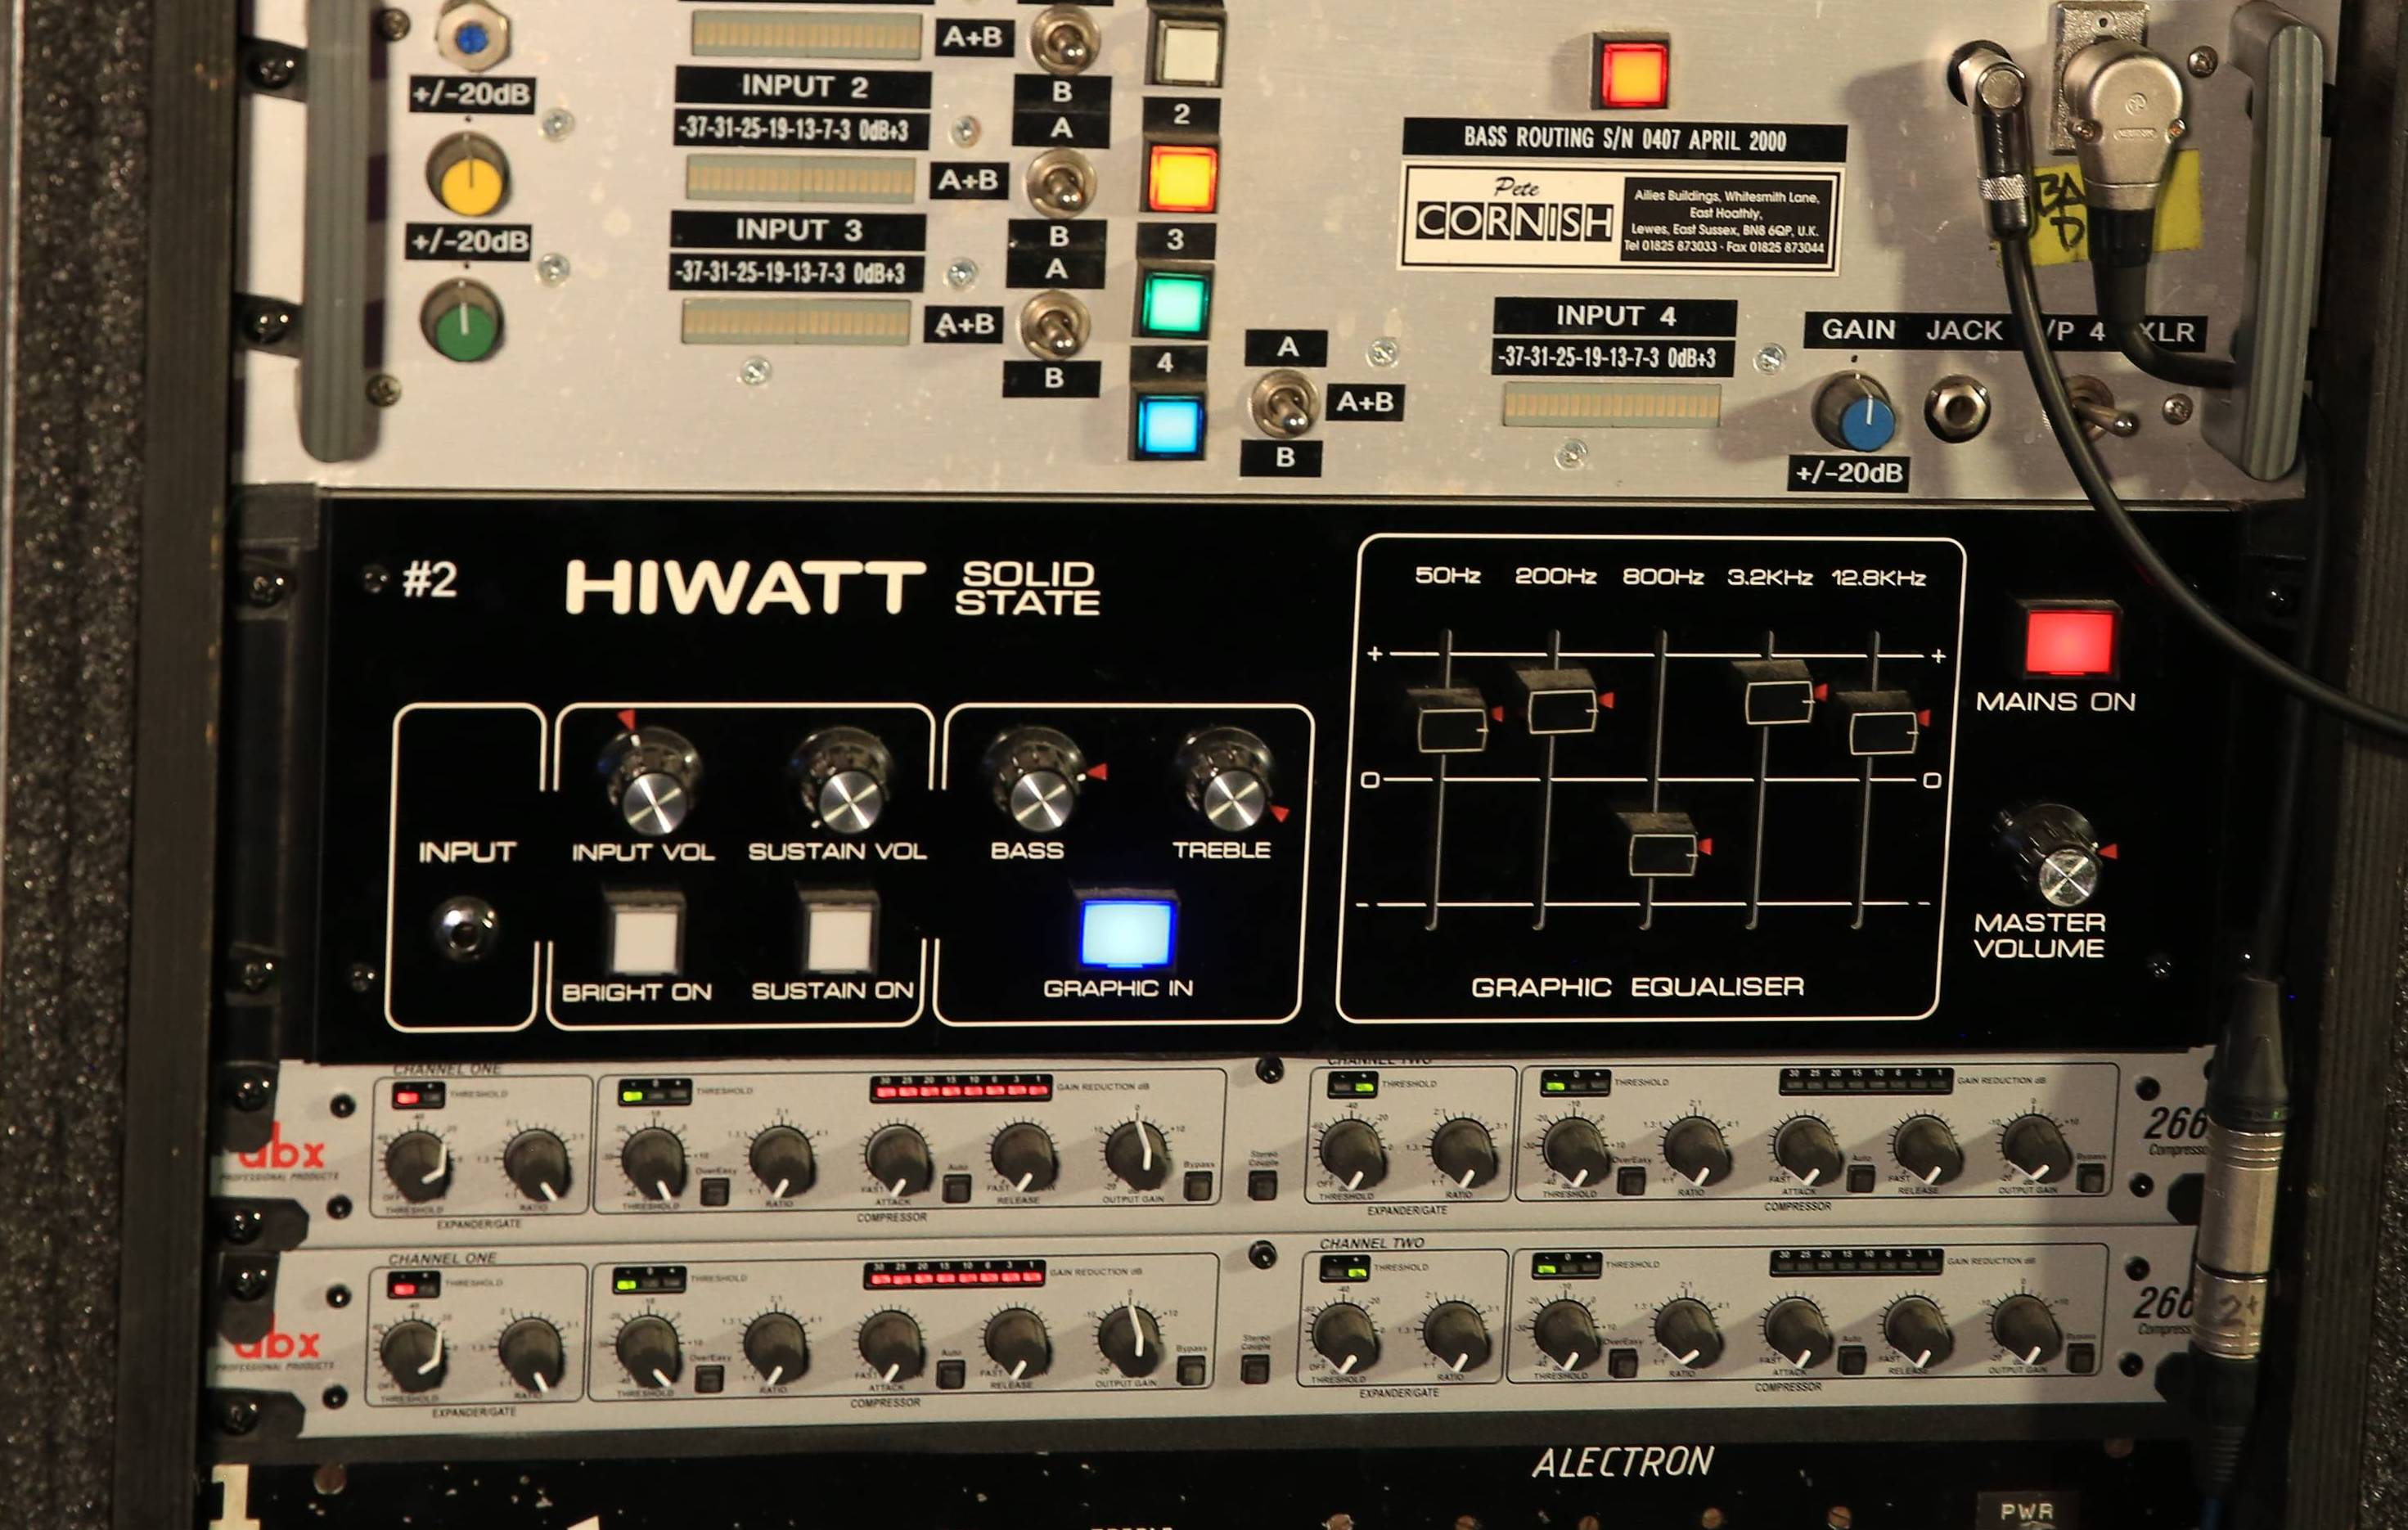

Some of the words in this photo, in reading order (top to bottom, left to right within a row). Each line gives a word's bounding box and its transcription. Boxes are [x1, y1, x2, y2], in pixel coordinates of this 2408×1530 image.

[942, 25, 1003, 47] A+B
[413, 79, 531, 106] +/-20dB
[742, 73, 836, 97] INPUT
[851, 76, 869, 99] 2
[1052, 80, 1073, 102] B
[1173, 103, 1190, 125] 2
[858, 118, 909, 142] 0dB+3
[1050, 116, 1073, 138] A
[1465, 125, 1508, 147] BASS
[1516, 126, 1595, 149] ROUTING
[1603, 125, 1634, 151] S/N
[1642, 128, 1681, 151] 0407
[1688, 129, 1741, 151] APRIL
[1749, 130, 1787, 152] 2000
[938, 169, 999, 191] A+B
[1494, 176, 1539, 197] Pete
[1724, 191, 1787, 203] Whitesmith
[1789, 191, 1821, 205] Lane,
[1416, 202, 1614, 241] CORNISH
[1690, 206, 1714, 218] East
[412, 225, 532, 256] +/-20dB
[736, 218, 830, 241] INPUT
[844, 218, 863, 242] 3
[1049, 225, 1069, 247] B
[1167, 227, 1184, 250] 3
[1672, 223, 1697, 236] East
[1698, 223, 1740, 237] Sussex,
[1797, 225, 1820, 237] U.K.
[1623, 239, 1640, 251] Tel
[1641, 239, 1675, 252] 01825
[1677, 240, 1717, 253] 873033
[1726, 241, 1748, 253] Fax
[1749, 241, 1782, 254] 01825
[1784, 241, 1825, 254] 873044
[853, 261, 906, 285] 0dB+3
[1045, 257, 1069, 279] A
[934, 313, 995, 337] A+B
[1557, 304, 1646, 326] INPUT
[1659, 306, 1677, 326] 4
[1822, 318, 1896, 340] GAIN
[1926, 319, 2004, 341] JACK
[2045, 317, 2077, 343] /P
[2089, 322, 2106, 341] 4
[1276, 335, 1300, 357] A
[1156, 352, 1174, 373] 4
[1668, 346, 1717, 369] 0dB+3
[1045, 367, 1064, 389] B
[1336, 390, 1394, 412] A+B
[1276, 446, 1295, 468] B
[1796, 459, 1904, 484] +/-20dB
[403, 560, 457, 597] #2
[962, 560, 1095, 587] SOLID
[1415, 566, 1482, 584] 50Hz
[1515, 567, 1598, 585] 200Hz
[1623, 568, 1705, 586] 800Hz
[1727, 568, 1814, 586] 3.2KHz
[1831, 569, 1927, 587] 12.8KHz
[565, 559, 927, 615] HIWATT
[955, 589, 1101, 616] STATE
[1976, 691, 2077, 712] MAINS
[2091, 691, 2136, 712] ON
[419, 841, 518, 863] INPUT
[572, 843, 654, 862] INPUT
[662, 843, 716, 862] VOL
[749, 842, 866, 862] SUSTAIN
[874, 842, 928, 861] VOL
[991, 841, 1064, 860] BASS
[1172, 841, 1272, 859] TREBLE
[1974, 912, 2106, 933] MASTER
[1973, 938, 2105, 959] VOLUME
[562, 983, 664, 1002] BRIGHT
[671, 983, 713, 1001] ON
[752, 981, 866, 1001] SUSTAIN
[875, 981, 915, 1000] ON
[1043, 979, 1159, 998] GRAPHIC
[1168, 979, 1194, 997] IN
[1472, 977, 1613, 998] GRAPHIC
[1631, 976, 1805, 997] EQUALISER
[1382, 1080, 1438, 1088] THRESHOLD
[1614, 1078, 1670, 1087] THRESHOLD
[1982, 1077, 2032, 1085] REDUCTION
[2149, 1144, 2208, 1157] Compresso
[1367, 1205, 1448, 1217] EXPANDER/GATE
[1764, 1201, 1832, 1212] COMPRESSOR
[437, 1219, 521, 1231] EXPANDER/GATE
[857, 1212, 927, 1223] COMPRESSOR
[1320, 1238, 1388, 1250] CHANNEL
[1393, 1236, 1425, 1249] TWO
[388, 1253, 461, 1267] CHANNEL
[464, 1252, 497, 1266] ONE
[1374, 1263, 1429, 1271] THRESHOLD
[1605, 1260, 1660, 1269] THRESHOLD
[1359, 1388, 1440, 1399] EXPANDER/GATE
[1755, 1381, 1822, 1393] COMPRESSOR
[433, 1406, 517, 1418] EXPANDER/GATE
[850, 1398, 922, 1409] COMPRESSOR
[1531, 1445, 1715, 1478] ALECTRON
[2001, 1502, 2053, 1522] PWR
